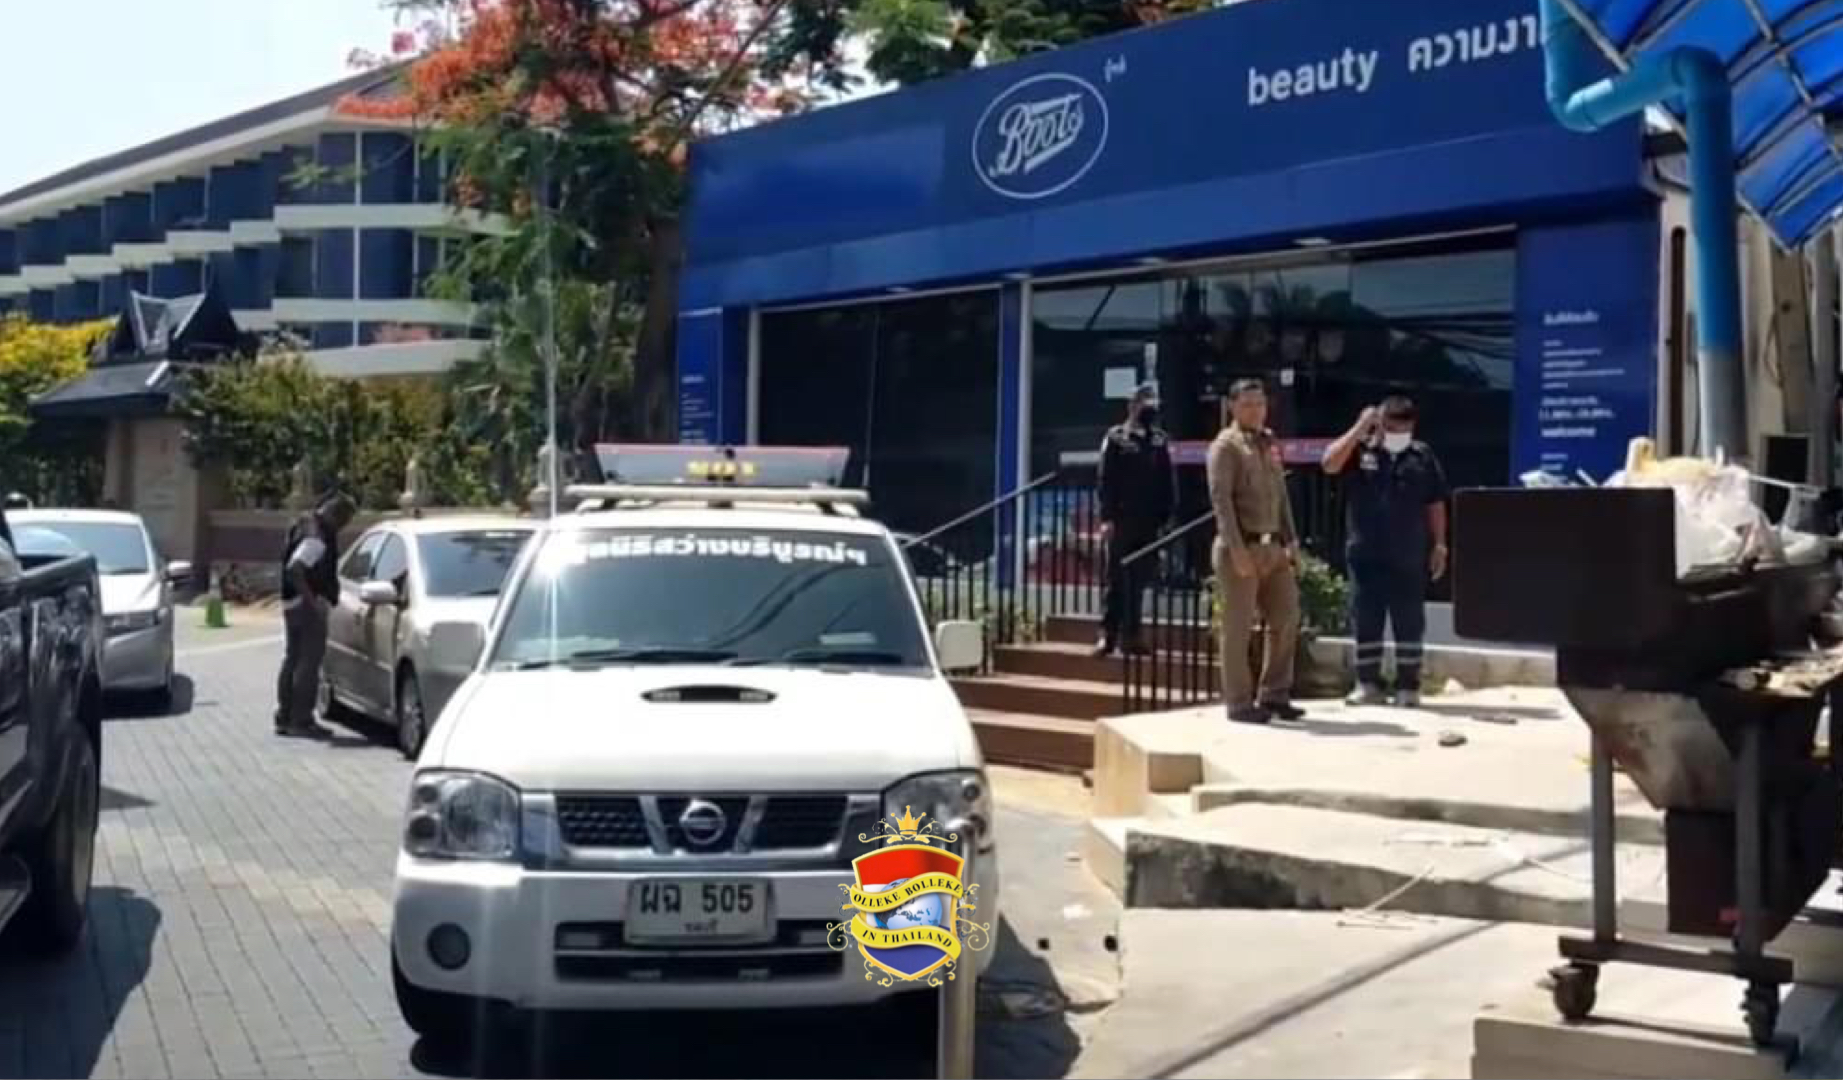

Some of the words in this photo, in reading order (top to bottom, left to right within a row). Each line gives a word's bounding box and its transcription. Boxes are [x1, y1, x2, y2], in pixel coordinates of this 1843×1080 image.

[1408, 15, 1537, 73] ความงา
[1249, 48, 1378, 106] beauty
[988, 92, 1085, 178] Boots
[702, 883, 754, 914] 505
